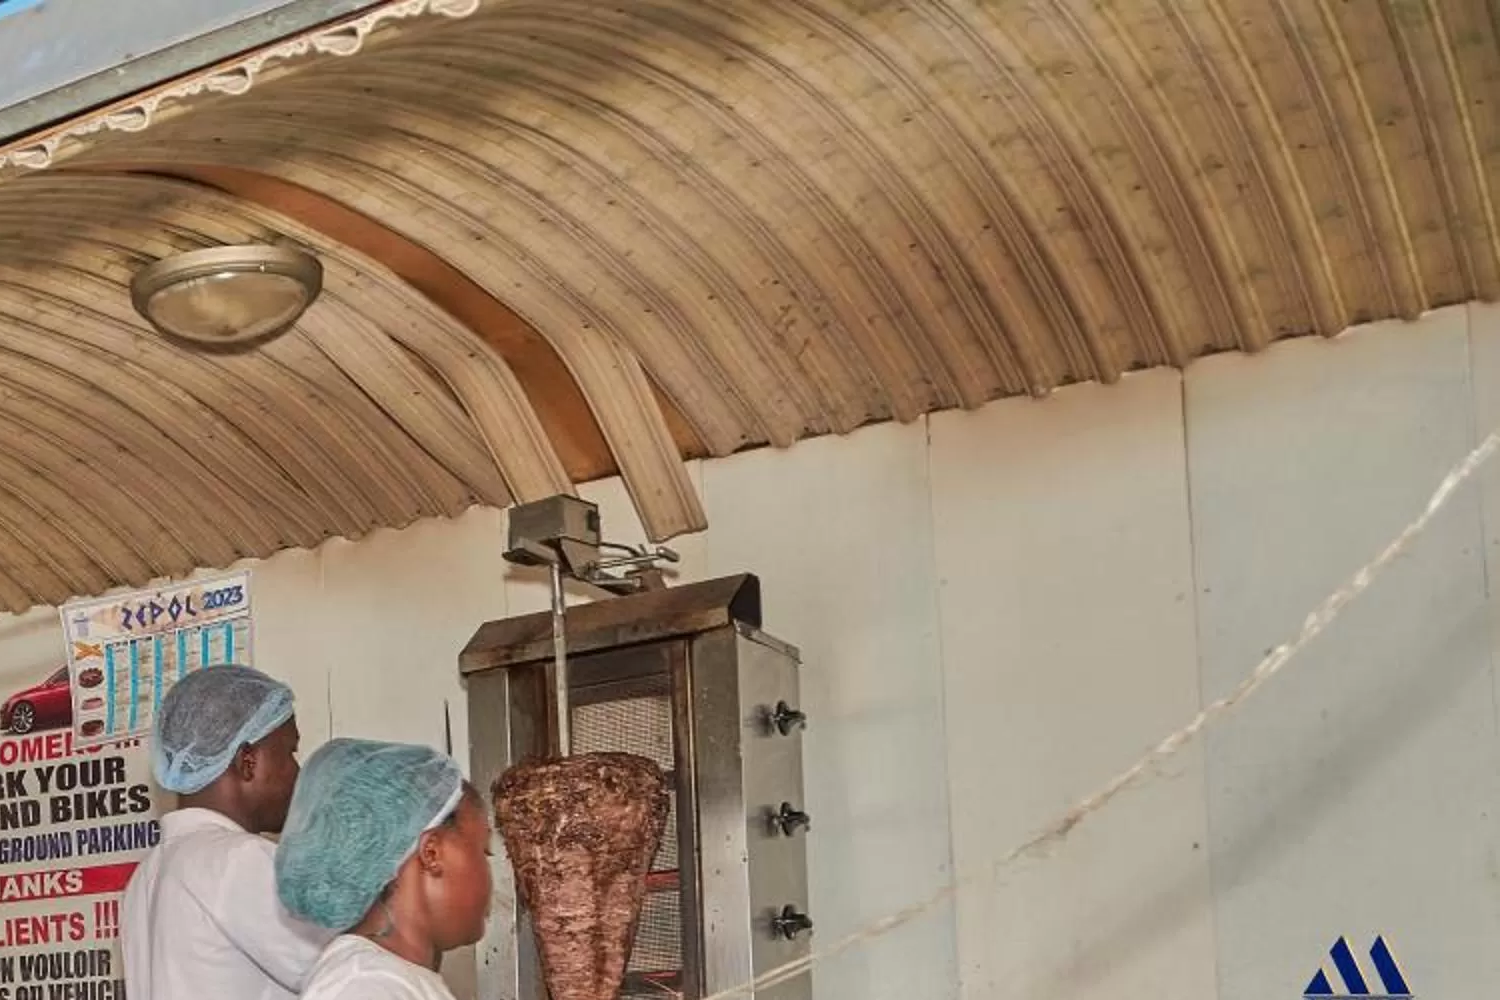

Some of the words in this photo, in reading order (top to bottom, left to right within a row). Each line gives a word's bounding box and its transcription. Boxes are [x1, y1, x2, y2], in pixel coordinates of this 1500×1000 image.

[202, 585, 243, 609] 2023
[34, 756, 125, 794] YOUR
[50, 784, 151, 825] BIKES
[76, 820, 161, 857] PARKING
[19, 949, 111, 982] VOULOIR
